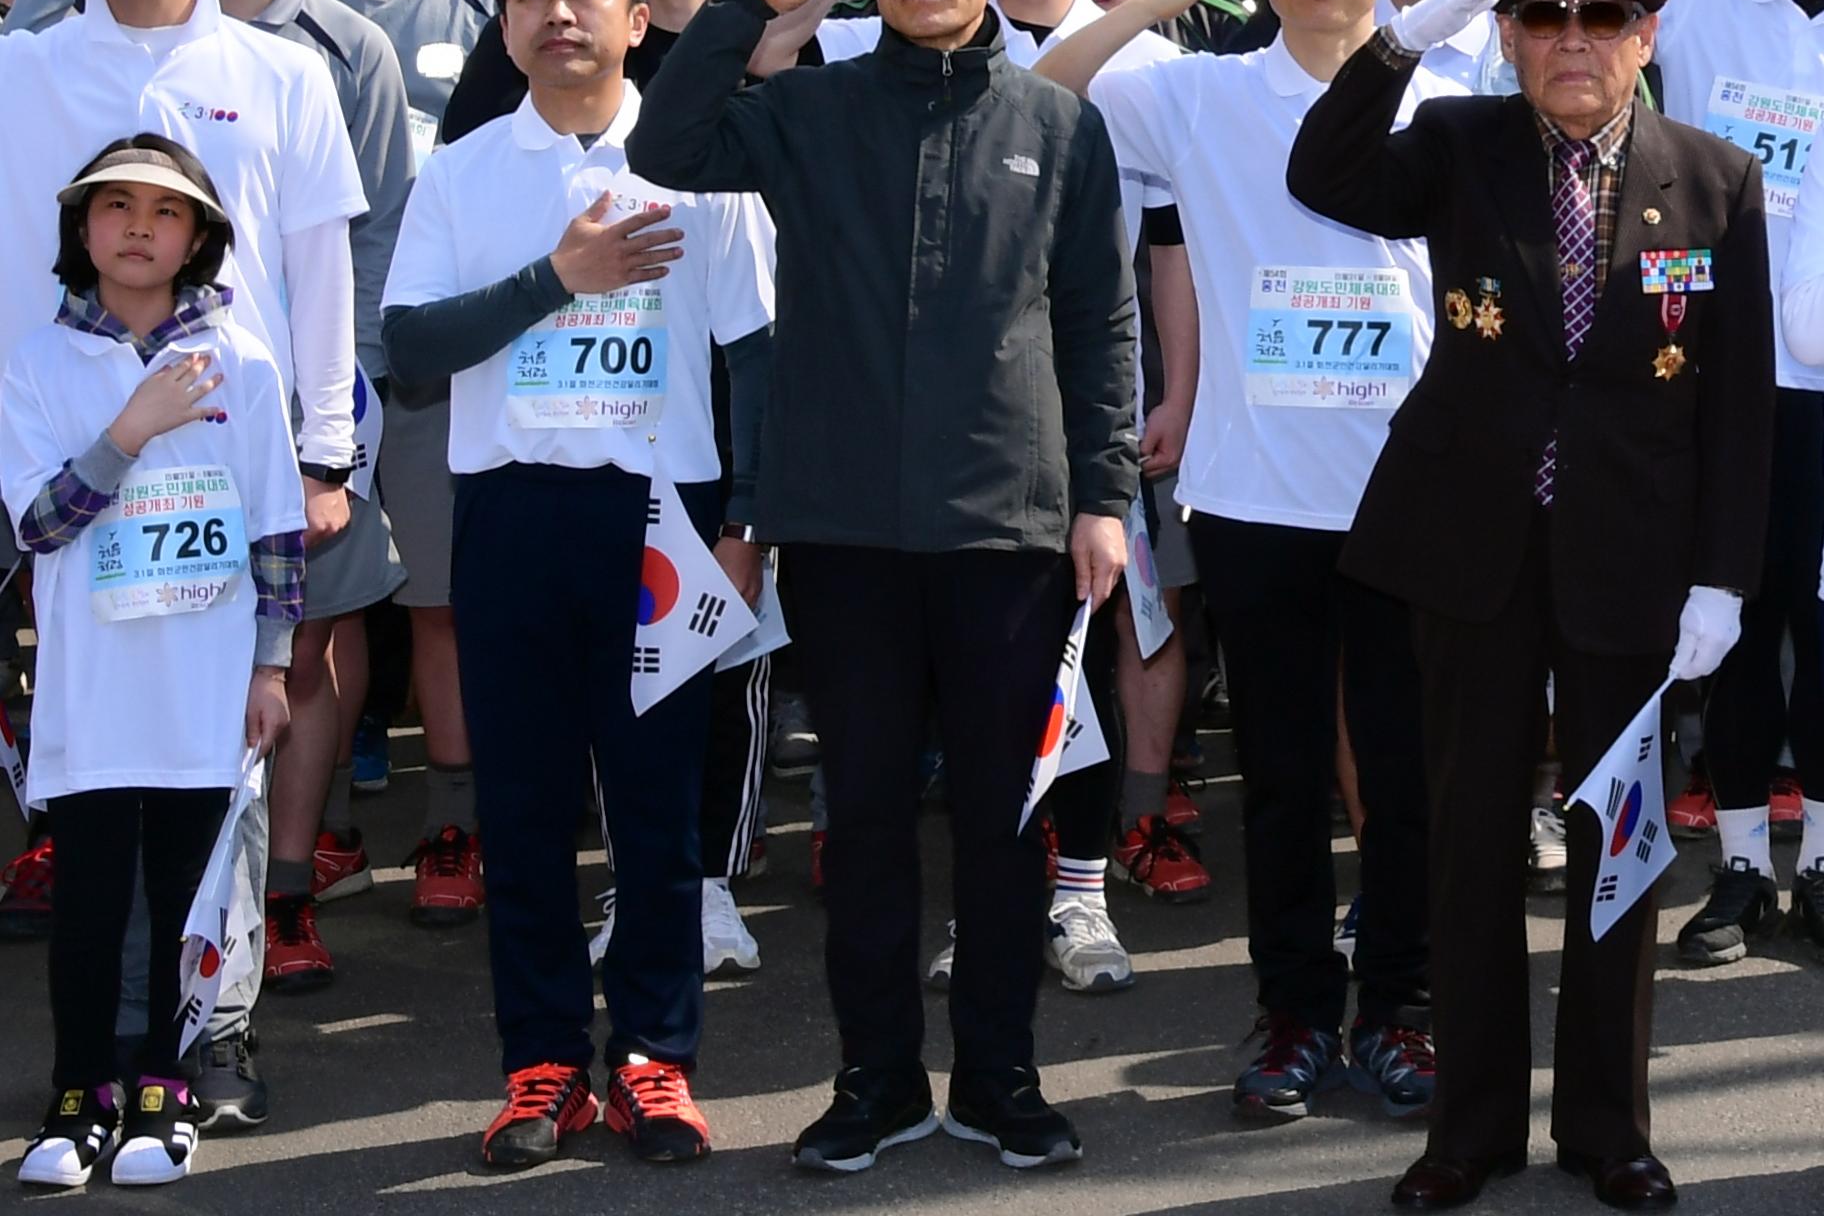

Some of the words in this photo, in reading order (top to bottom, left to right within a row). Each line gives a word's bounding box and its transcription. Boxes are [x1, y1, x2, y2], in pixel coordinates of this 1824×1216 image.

[1721, 89, 1744, 104] 홍천
[1744, 107, 1787, 126] 성공개최
[1791, 117, 1814, 133] 기원
[1261, 279, 1287, 293] 홍천
[1292, 279, 1401, 296] 강원도민체육대회
[1290, 295, 1341, 309] 성공개최
[1347, 296, 1372, 310] 기원
[554, 313, 605, 328] 성공개최
[610, 312, 636, 326] 기원
[1307, 319, 1392, 357] 777
[570, 336, 653, 375] 700
[1337, 381, 1387, 399] high1
[123, 478, 230, 502] 강원도민체육대회
[123, 498, 175, 517] 성공개최
[181, 494, 205, 509] 기원
[142, 517, 229, 562] 726
